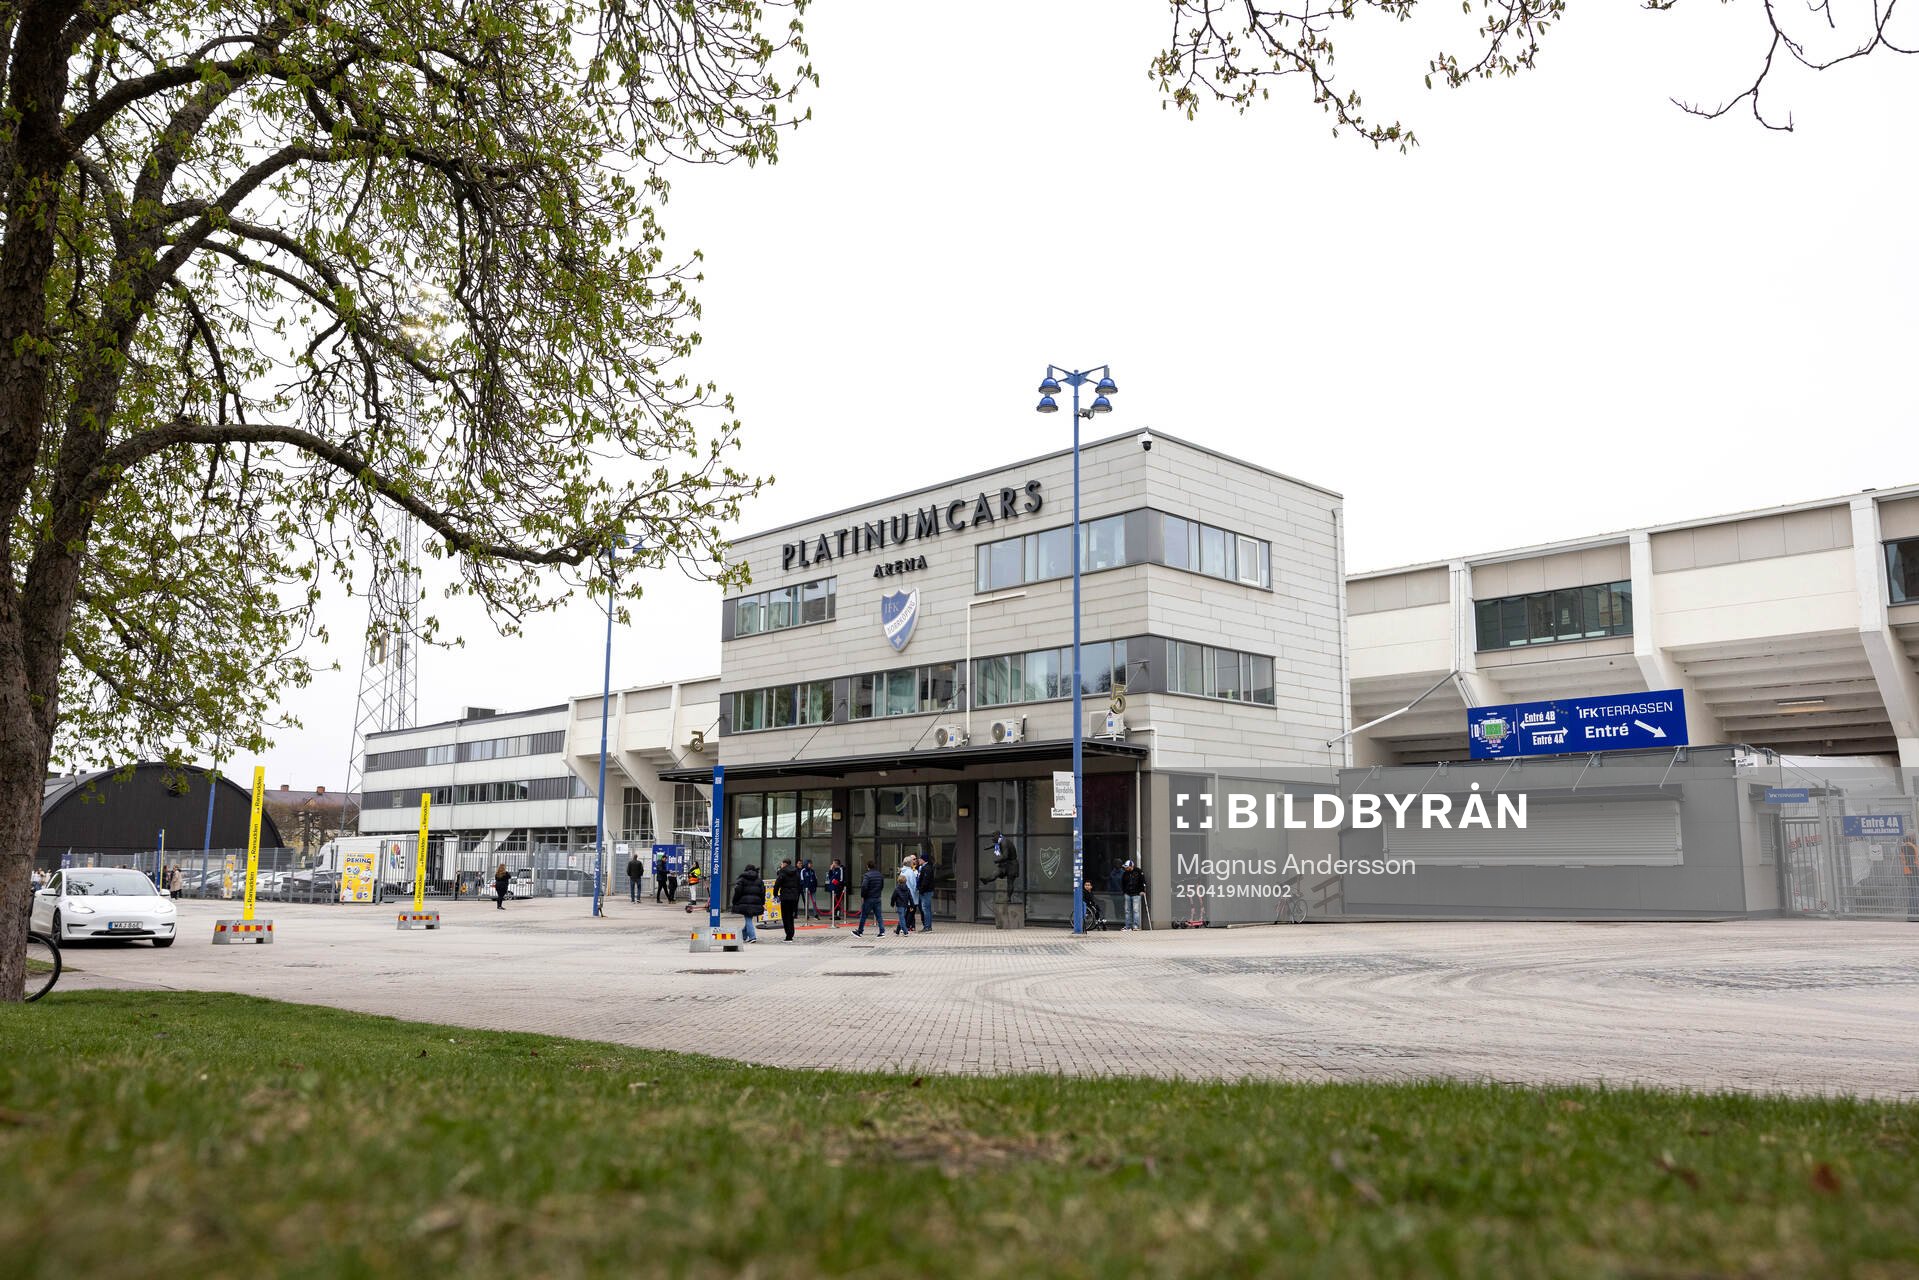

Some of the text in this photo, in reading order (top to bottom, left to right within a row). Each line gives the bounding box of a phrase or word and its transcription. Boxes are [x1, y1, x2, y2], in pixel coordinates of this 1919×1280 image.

[783, 480, 1042, 570] PLATINUMCARS
[874, 555, 928, 577] ARENA
[1110, 683, 1127, 714] 5
[1524, 711, 1556, 723] Entré 4B
[1532, 733, 1564, 746] Entré 4A
[1585, 723, 1629, 739] Entré
[1861, 817, 1899, 828] Entré 4A
[251, 823, 259, 854] Ramudden
